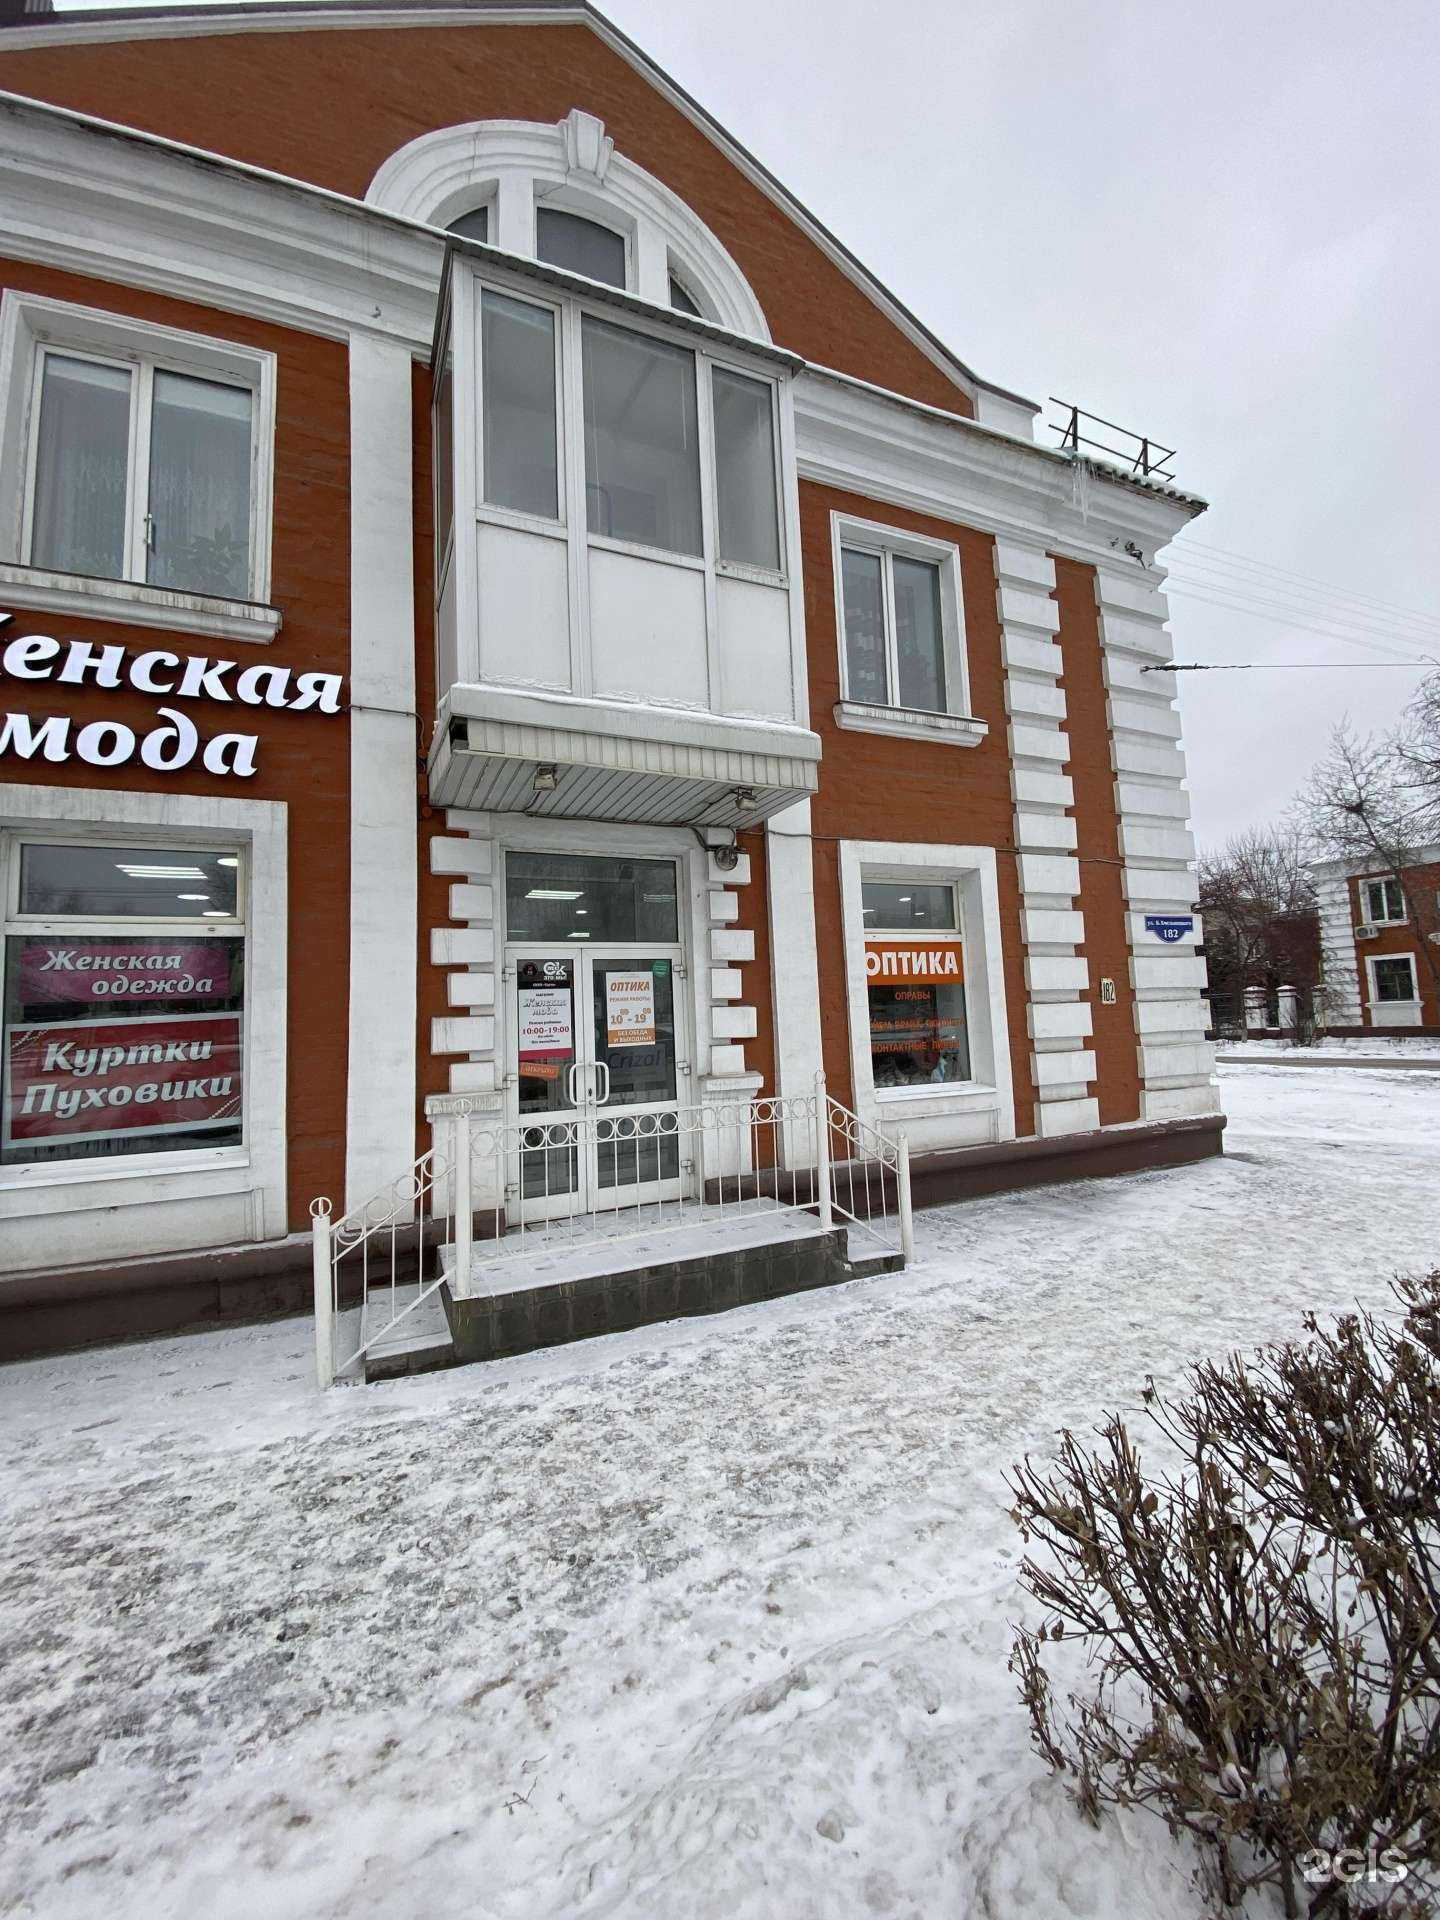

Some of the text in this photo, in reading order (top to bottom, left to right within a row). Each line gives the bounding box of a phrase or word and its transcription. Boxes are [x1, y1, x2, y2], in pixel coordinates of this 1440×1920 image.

[0, 613, 344, 714] енская
[0, 706, 259, 777] мода
[1163, 929, 1179, 938] 182
[40, 950, 183, 971] Женская
[865, 951, 959, 976] ОПТИКА
[92, 974, 213, 995] одежда
[610, 981, 650, 992] ОПТИКА
[1103, 982, 1115, 1001] 182
[895, 991, 931, 1001] ОПРАВЫ
[42, 1040, 213, 1077] Куртки
[20, 1076, 232, 1119] Пуховики
